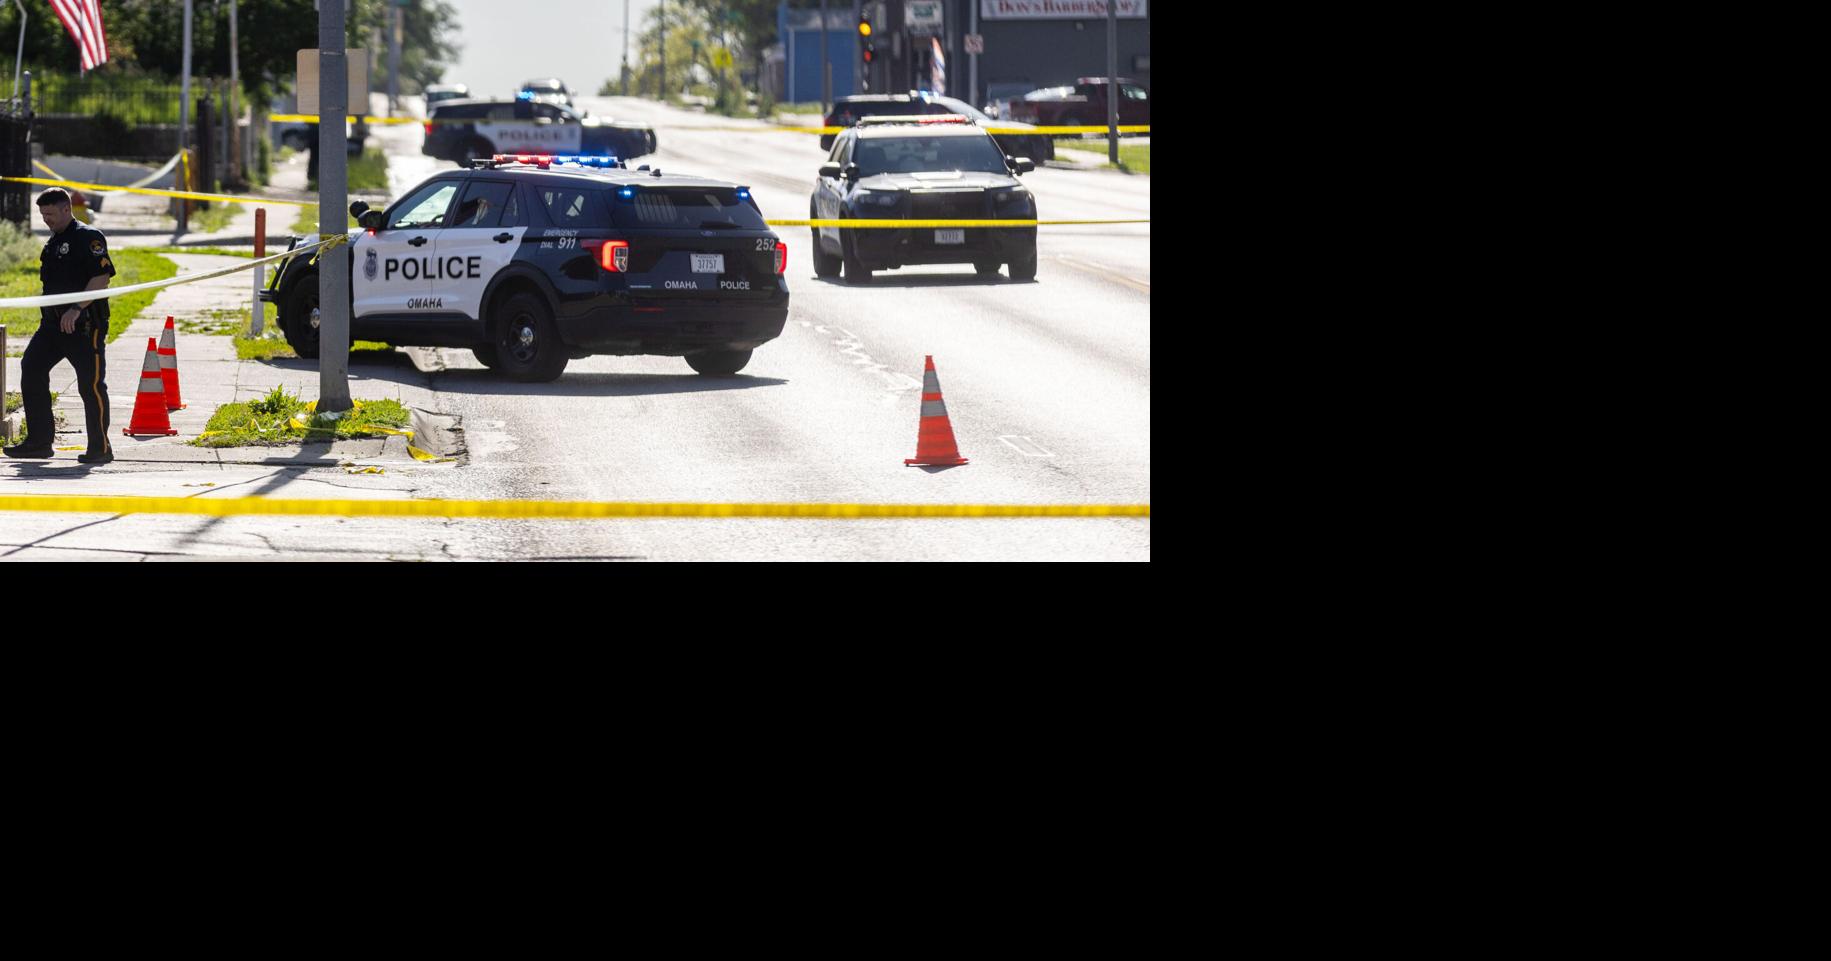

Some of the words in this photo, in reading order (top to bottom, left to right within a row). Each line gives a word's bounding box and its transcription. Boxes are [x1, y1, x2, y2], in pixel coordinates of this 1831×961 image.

[498, 129, 563, 141] POLICE
[540, 240, 554, 249] DIAL
[558, 237, 576, 249] 911
[755, 238, 775, 251] 252
[385, 256, 482, 281] POLICE
[664, 280, 698, 290] OMAHA
[720, 281, 750, 290] POLICE
[407, 298, 443, 309] OMAHA
